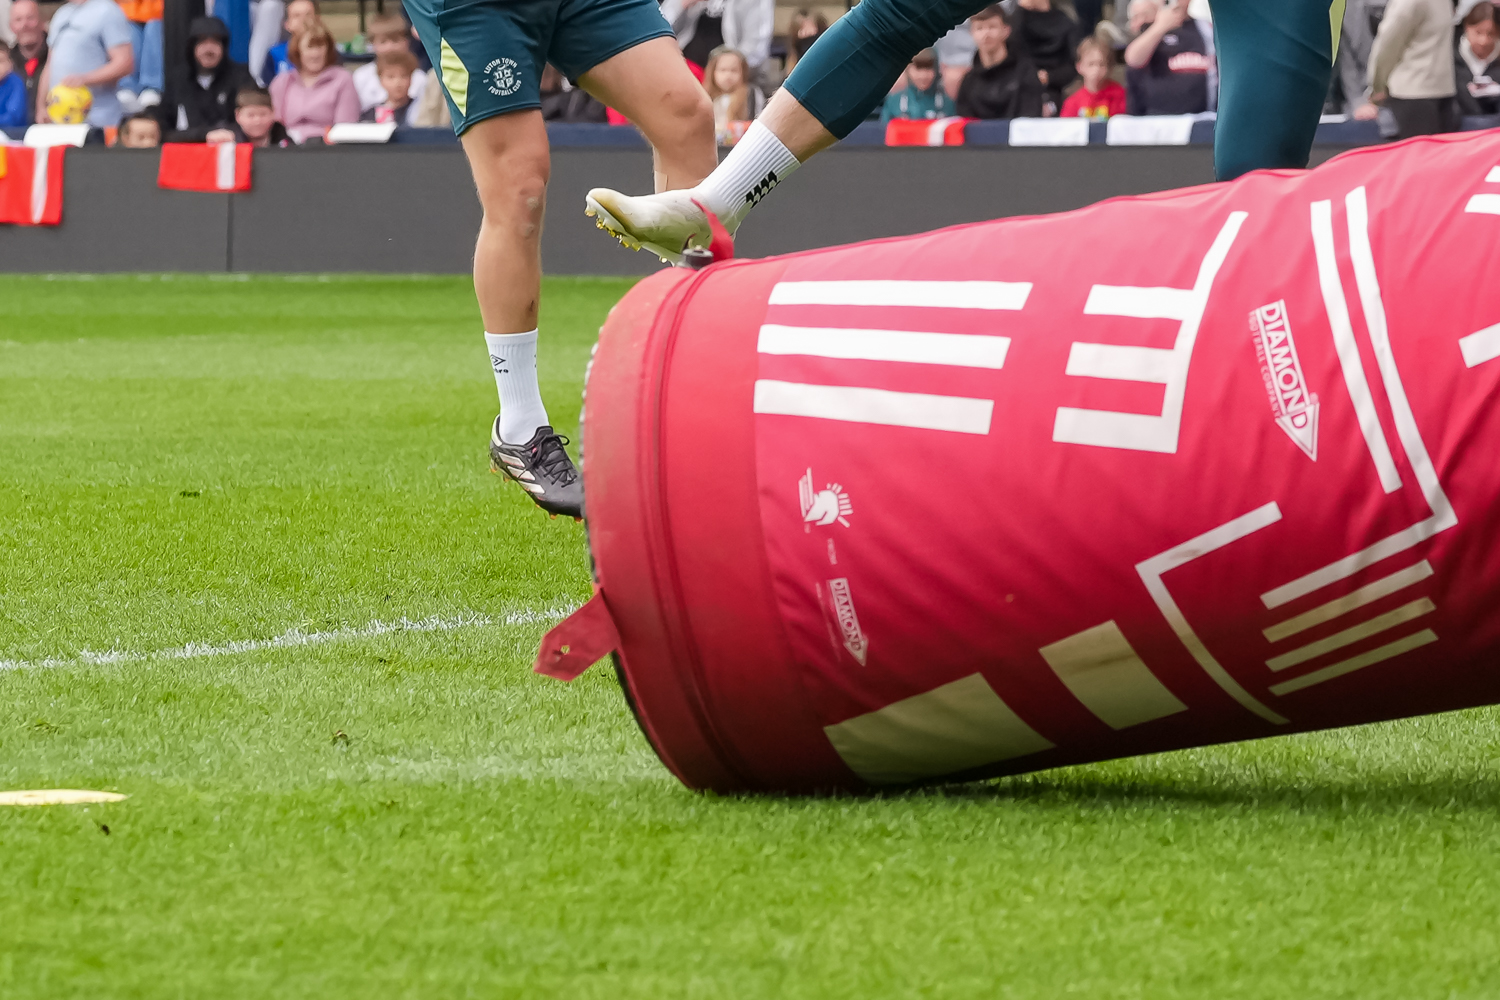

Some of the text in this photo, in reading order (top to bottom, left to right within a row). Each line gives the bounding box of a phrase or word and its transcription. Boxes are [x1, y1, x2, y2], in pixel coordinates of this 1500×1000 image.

[484, 57, 517, 74] LUTON TOWN
[488, 79, 522, 96] FOOTBALL CLUB
[1261, 304, 1308, 429] DIAMOND
[832, 579, 863, 652] DIAMOND
